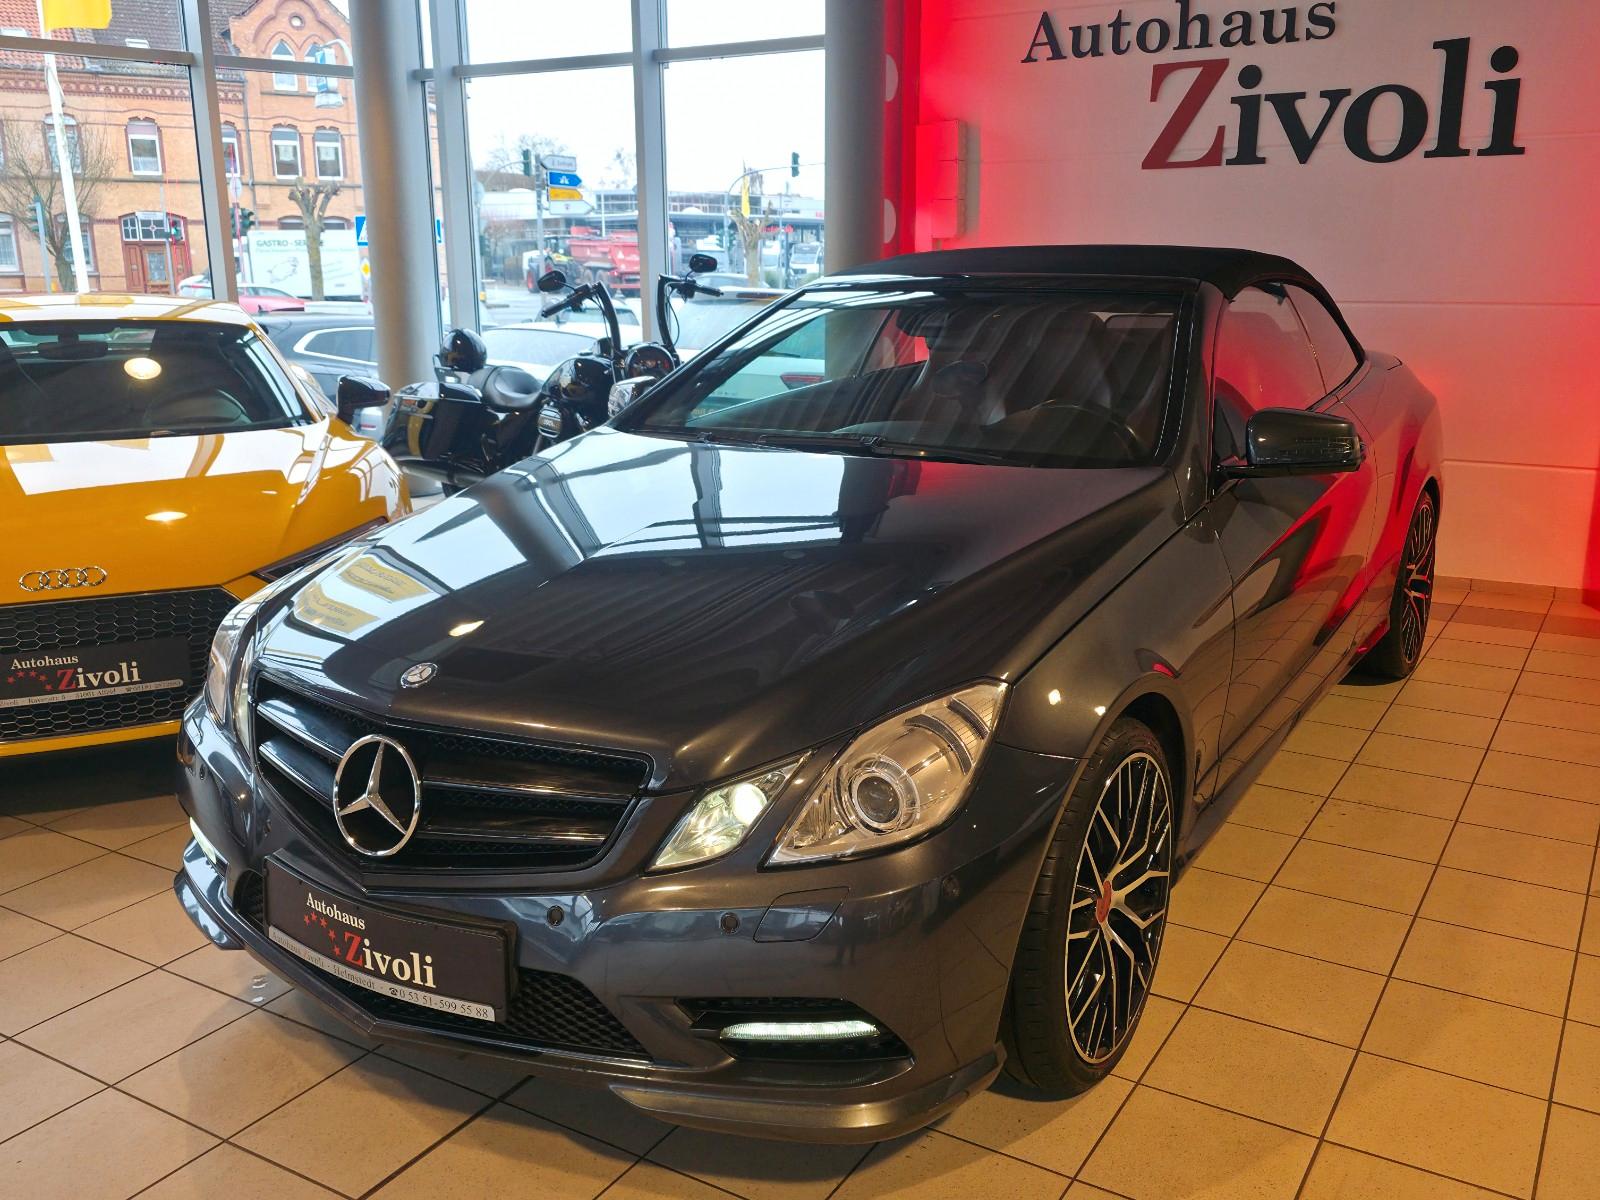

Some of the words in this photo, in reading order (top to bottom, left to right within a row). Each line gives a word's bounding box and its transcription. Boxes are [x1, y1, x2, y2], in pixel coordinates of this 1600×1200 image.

[1021, 0, 1336, 63] Autohaus
[1141, 37, 1525, 170] Zivoli
[10, 654, 79, 670] Autohaus
[56, 660, 142, 691] Zivoli
[306, 892, 365, 931] Autohaus
[344, 930, 436, 988] Zivoli
[333, 964, 375, 989] Helmstedt
[408, 991, 419, 1002] 53
[460, 1004, 473, 1015] 55
[475, 1006, 489, 1019] 88
